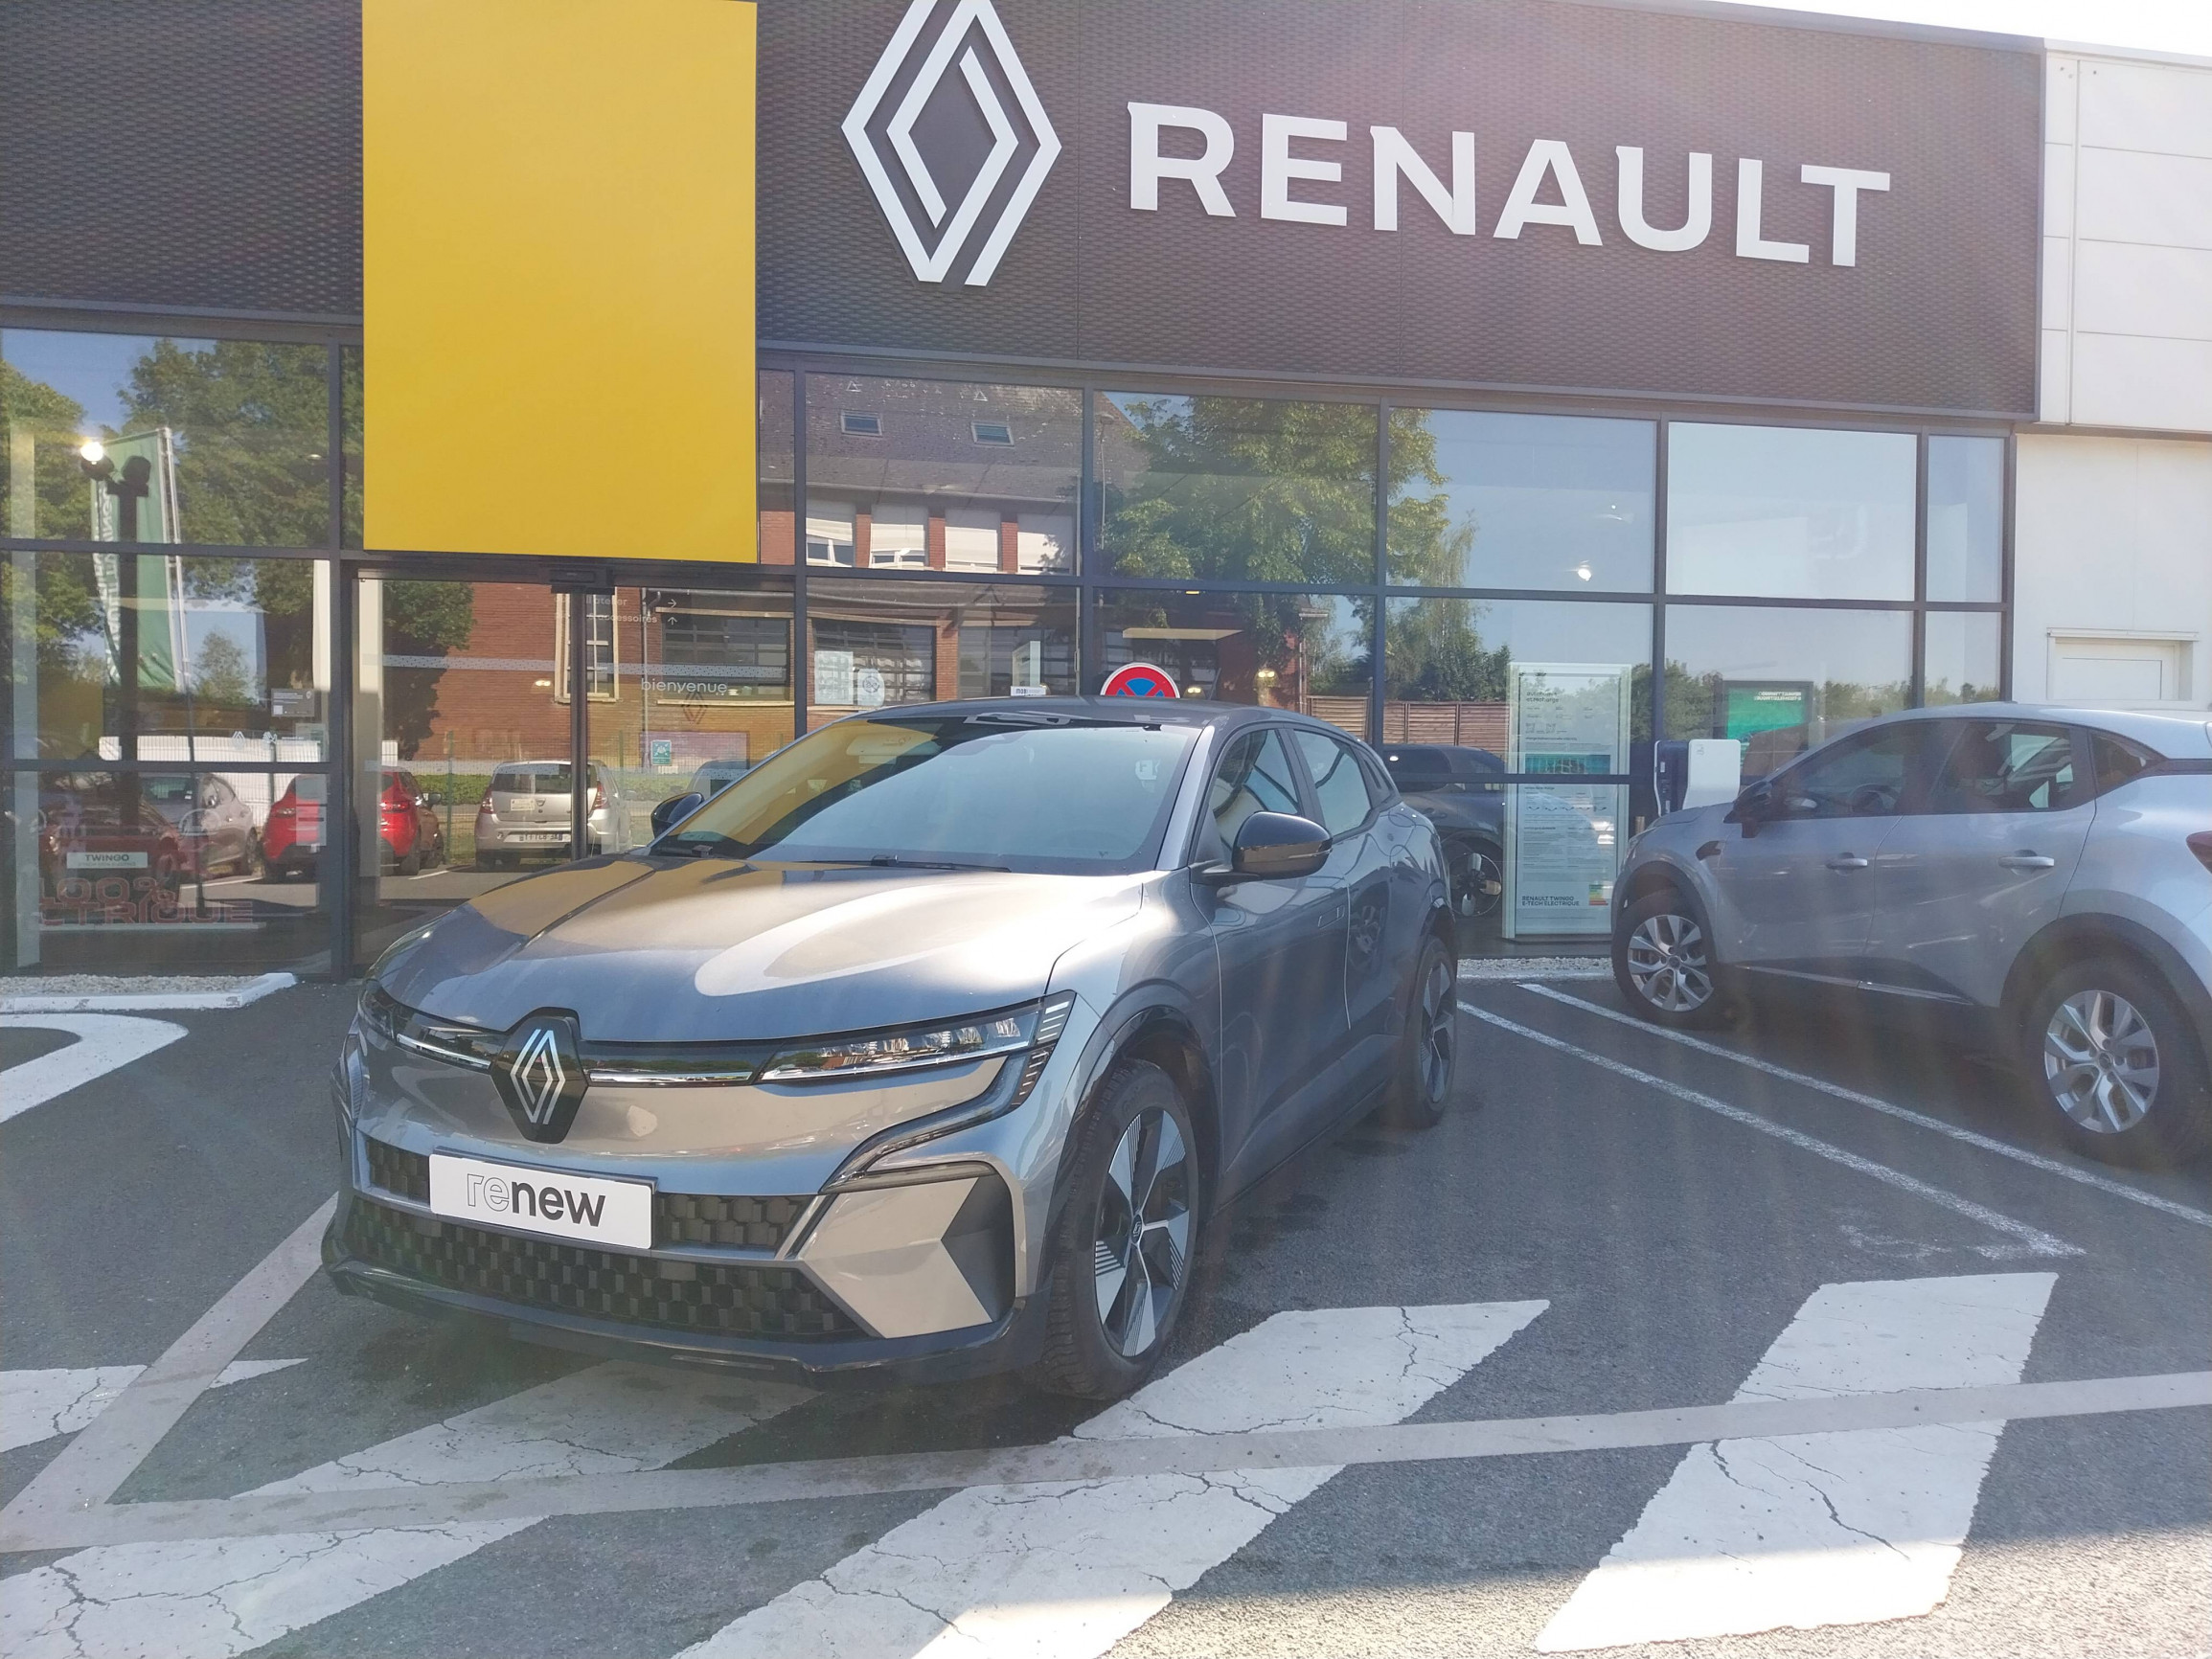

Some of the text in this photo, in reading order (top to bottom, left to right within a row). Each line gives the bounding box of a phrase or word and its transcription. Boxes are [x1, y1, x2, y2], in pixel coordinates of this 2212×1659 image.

[1128, 102, 1891, 267] RENAULT
[641, 677, 728, 693] bienvenue
[84, 853, 129, 862] TWINGO
[39, 900, 254, 925] CTRIQUE
[467, 1173, 606, 1227] renew
